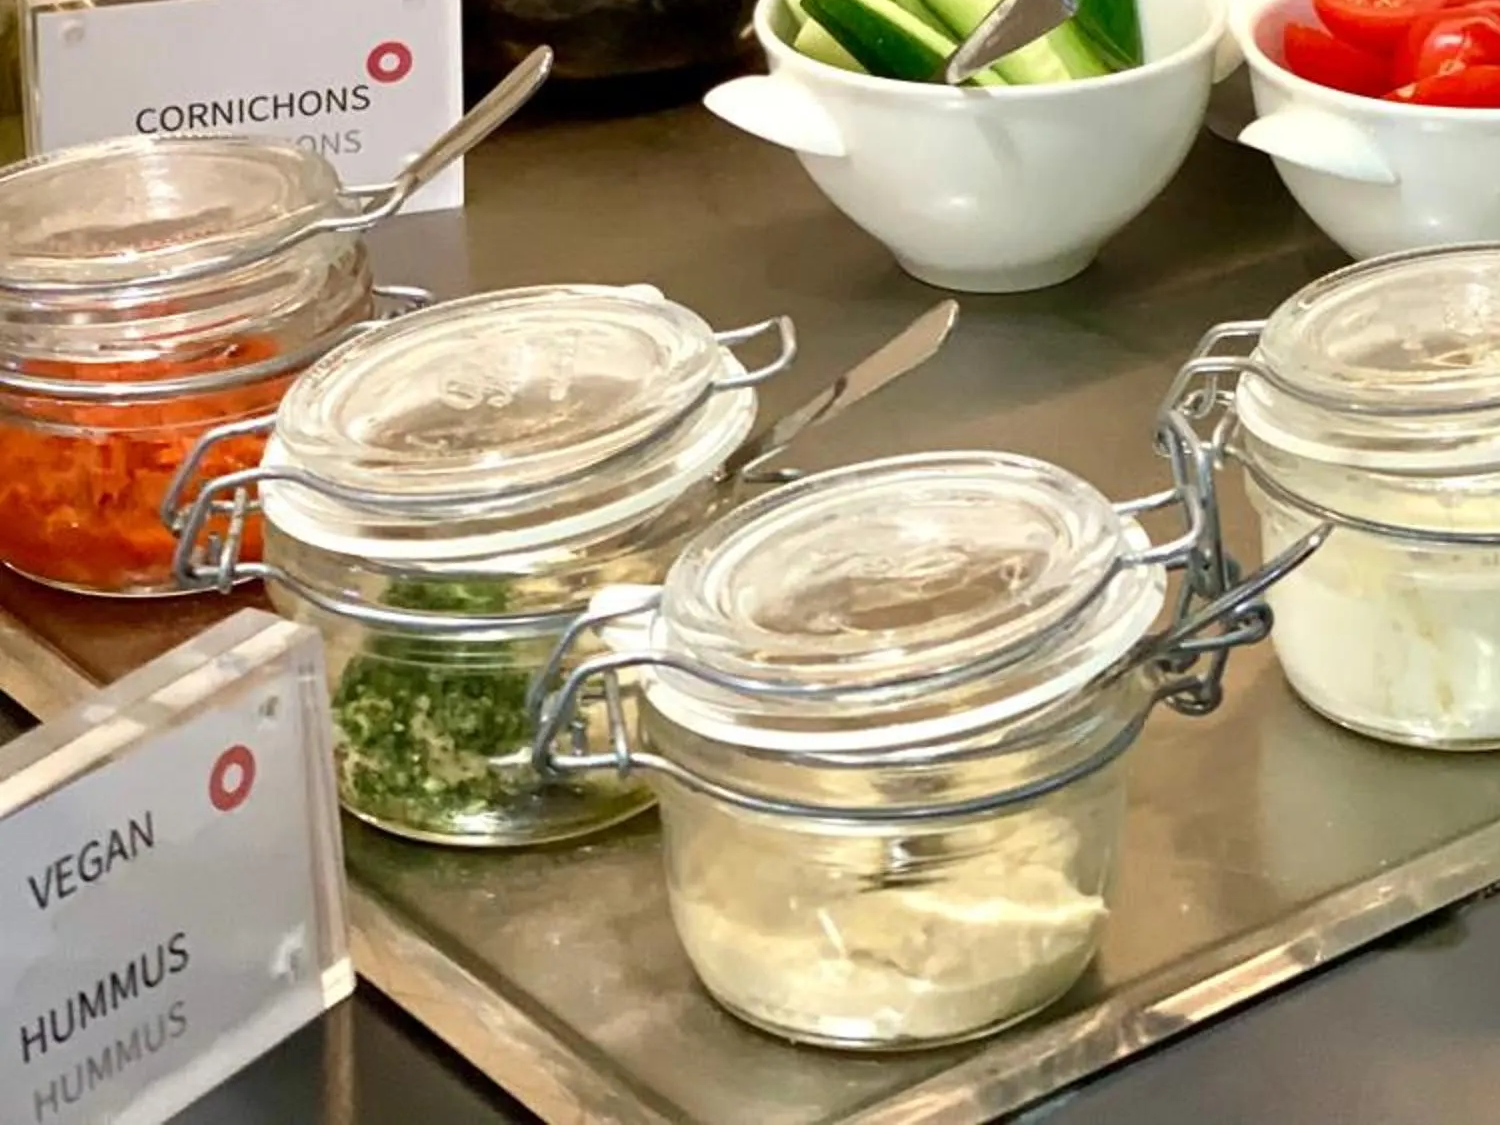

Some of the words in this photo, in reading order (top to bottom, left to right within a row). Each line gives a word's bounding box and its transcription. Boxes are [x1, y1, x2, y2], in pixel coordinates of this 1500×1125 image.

[135, 84, 371, 135] CORNICHONS
[27, 810, 155, 911] VEGAN
[20, 931, 190, 1064] HUMMUS
[33, 1000, 189, 1124] HUMMUS
